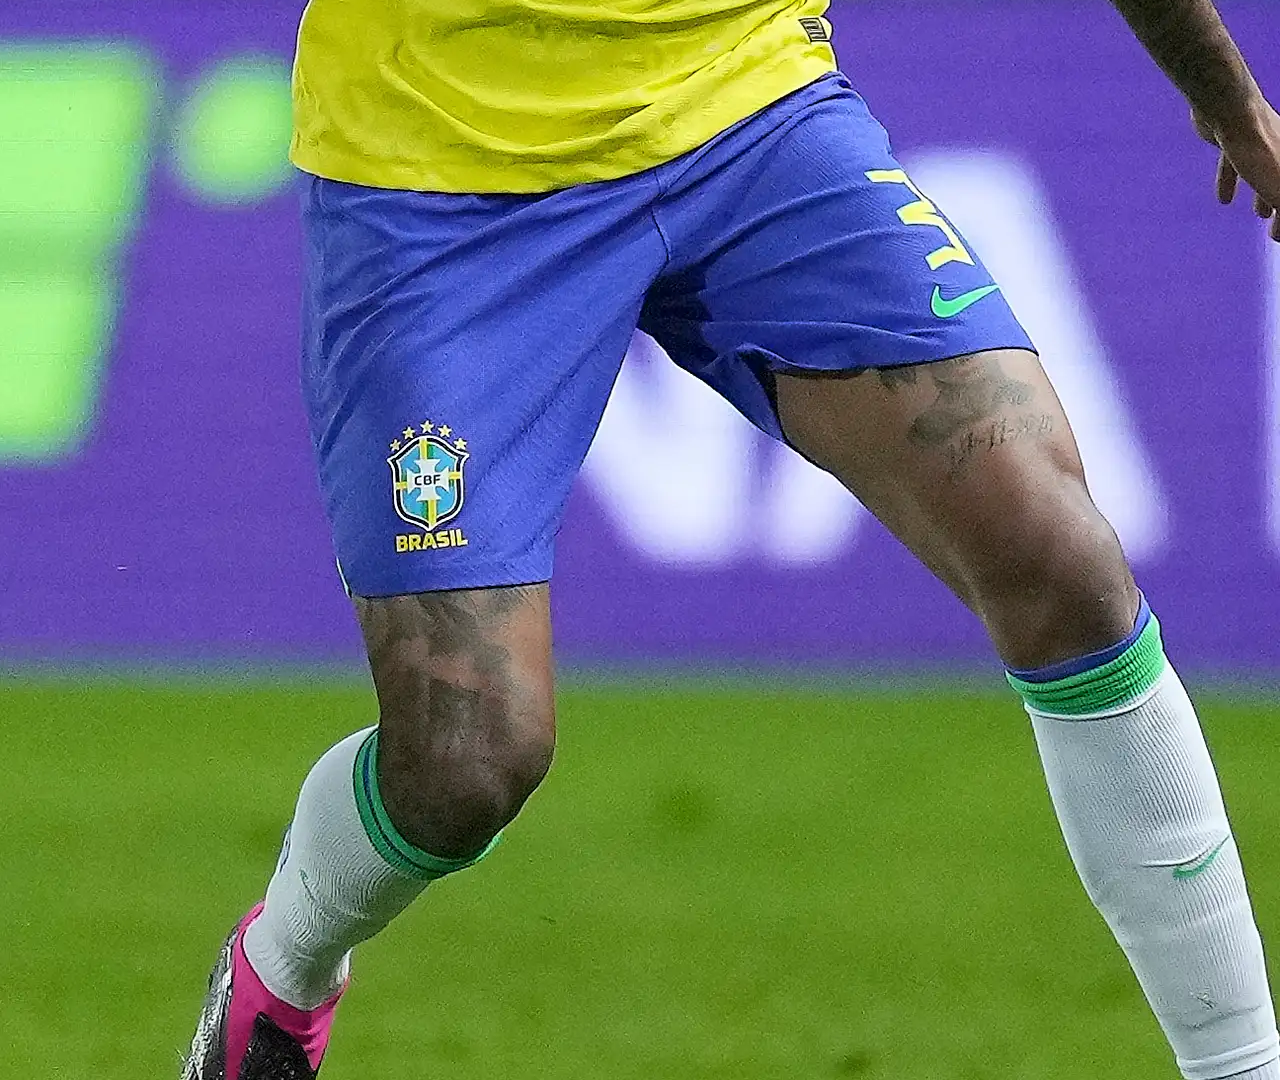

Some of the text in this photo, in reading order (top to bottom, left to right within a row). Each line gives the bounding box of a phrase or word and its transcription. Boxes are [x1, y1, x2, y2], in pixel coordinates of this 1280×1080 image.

[863, 168, 977, 272] 3
[414, 474, 441, 486] CBF
[395, 528, 469, 553] BRASIL
